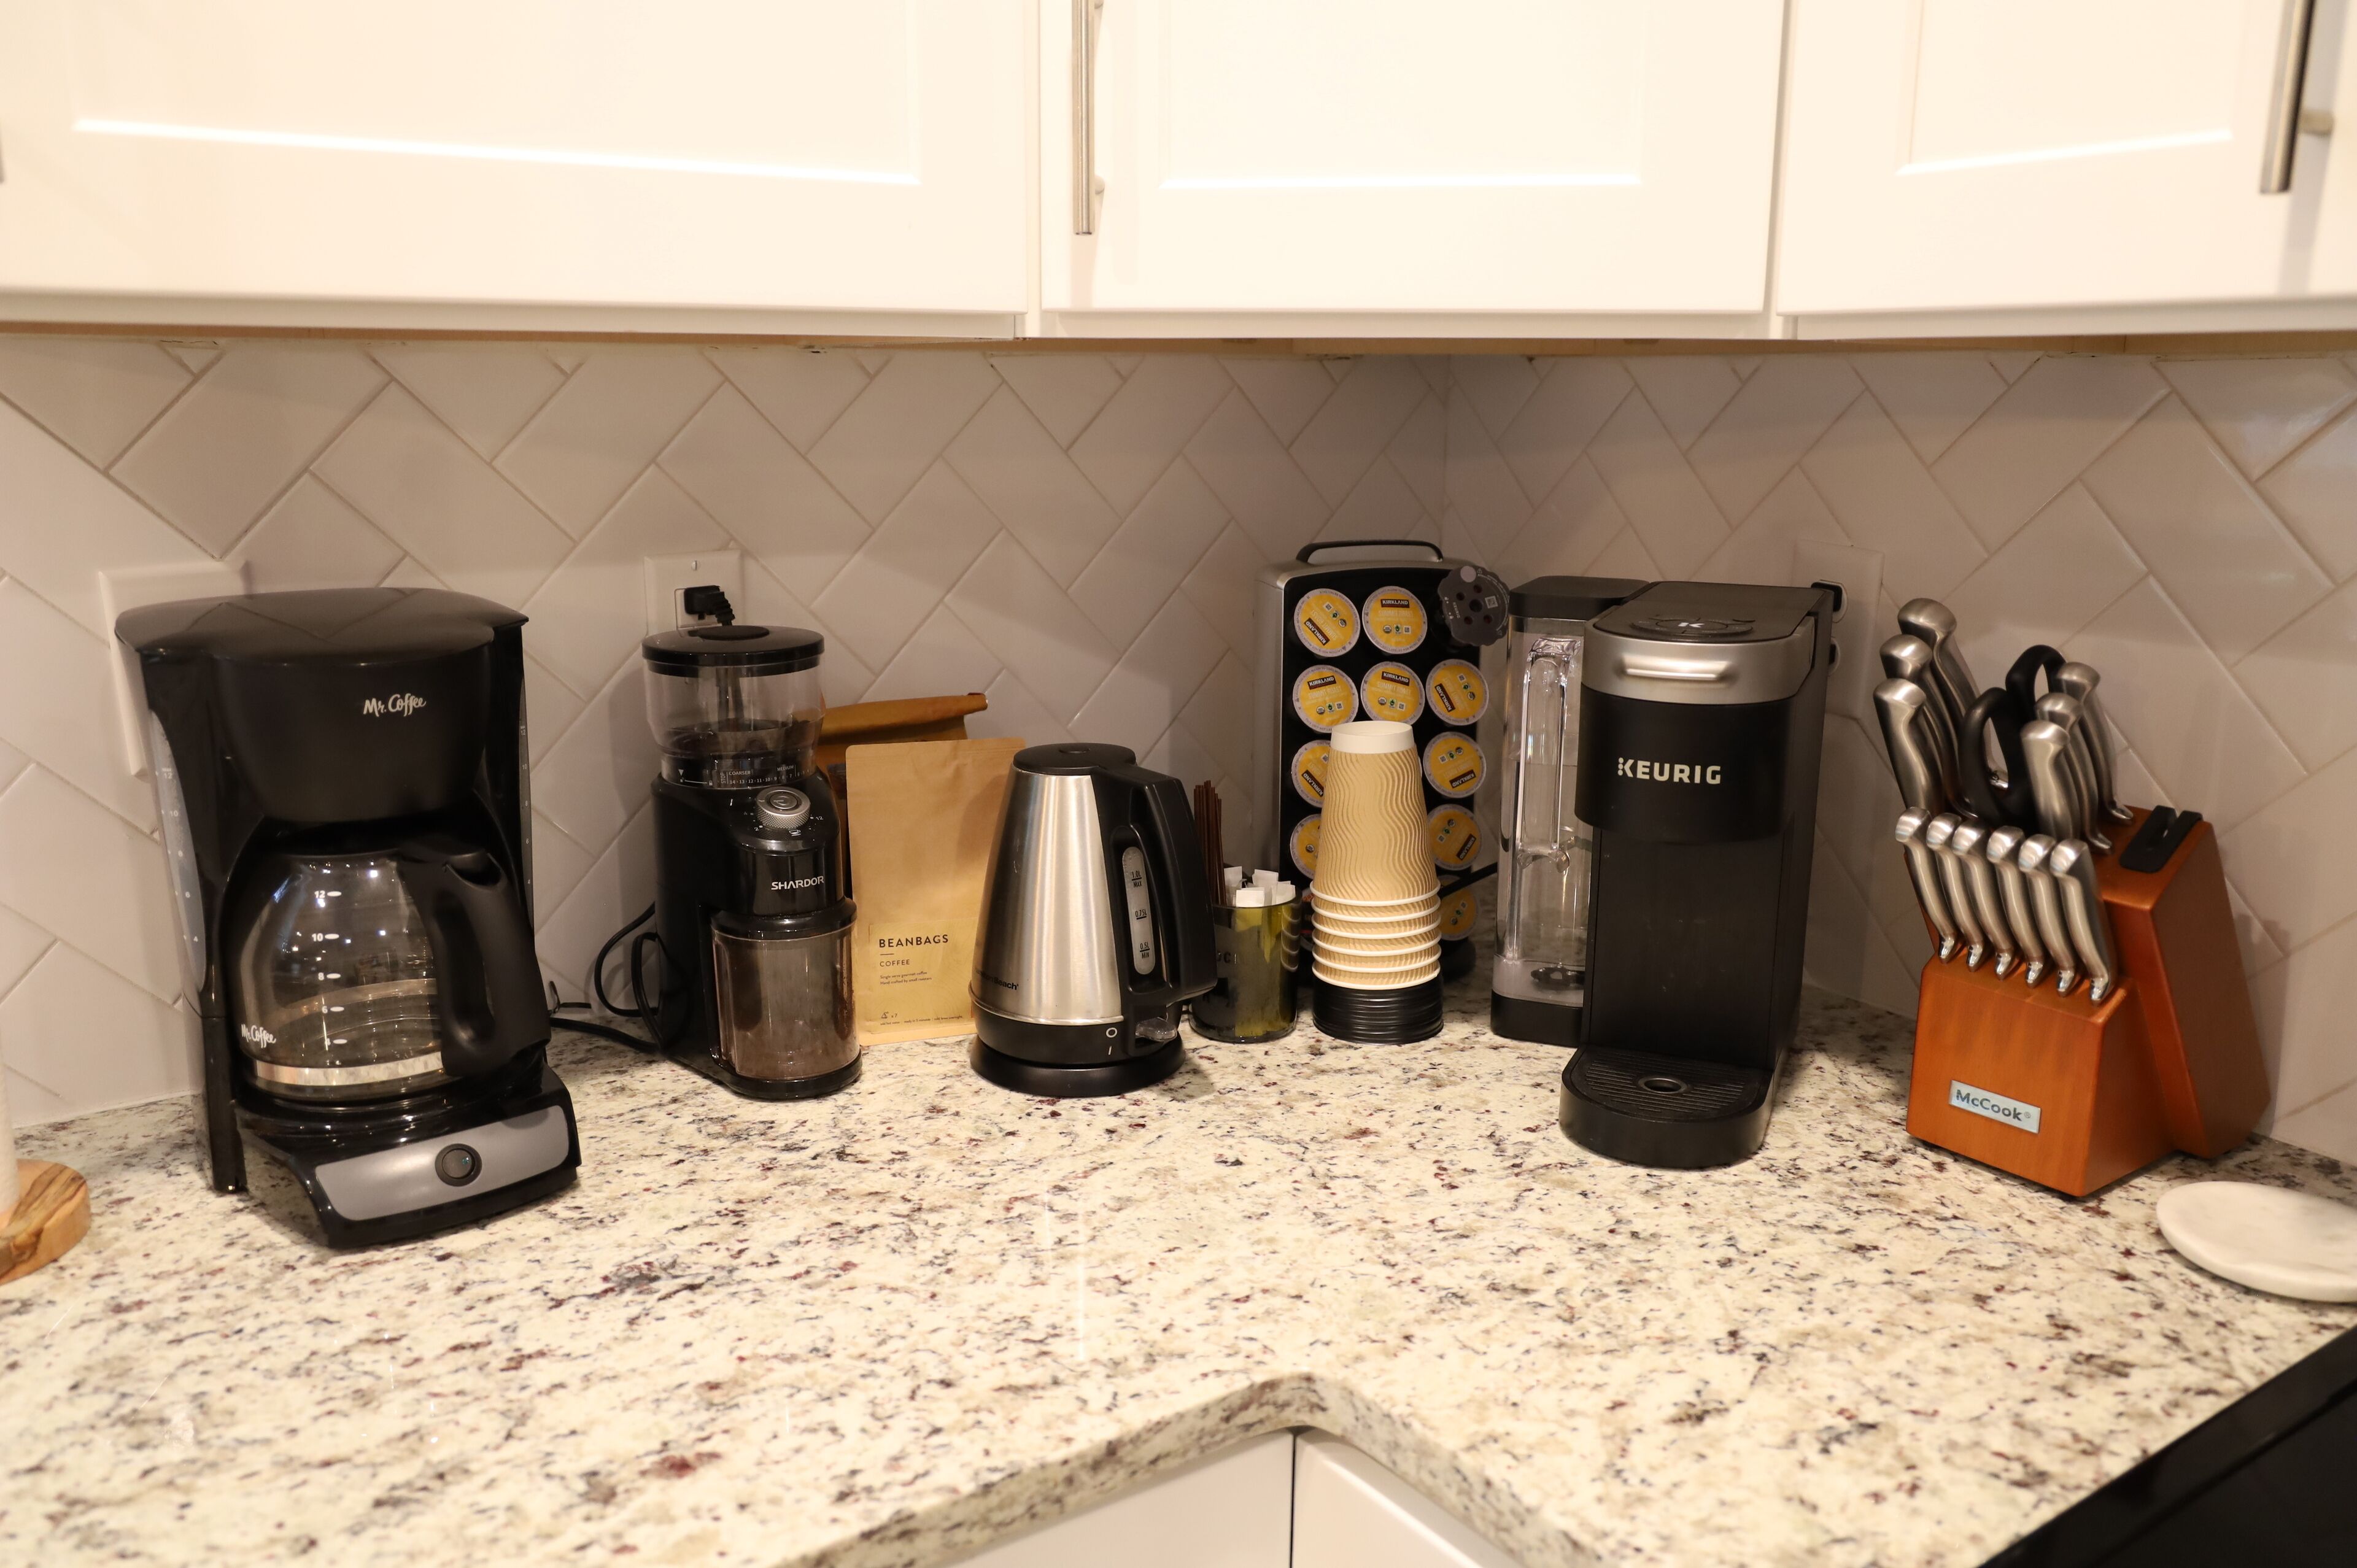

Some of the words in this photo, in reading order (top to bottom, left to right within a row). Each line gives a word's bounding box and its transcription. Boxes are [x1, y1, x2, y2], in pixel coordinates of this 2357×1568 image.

[1306, 621, 1326, 644] KIRKLAND
[1309, 676, 1334, 686] KIRKLAND
[1384, 673, 1409, 682] KIRKLAND
[363, 698, 387, 717] Mr.
[388, 693, 426, 717] Coffee
[1436, 686, 1452, 711] KIRKLAND
[1618, 757, 1721, 785] KEURIG
[1303, 773, 1323, 795] KIRKLAND
[1452, 773, 1475, 787] KIRKLAND
[770, 876, 824, 890] SHARDOR
[1135, 909, 1147, 917] 0.75L
[312, 933, 323, 942] 10
[879, 934, 949, 948] BEANBAGS
[880, 959, 910, 967] COFFEE
[318, 972, 325, 981] 8
[251, 1025, 276, 1048] Coffee
